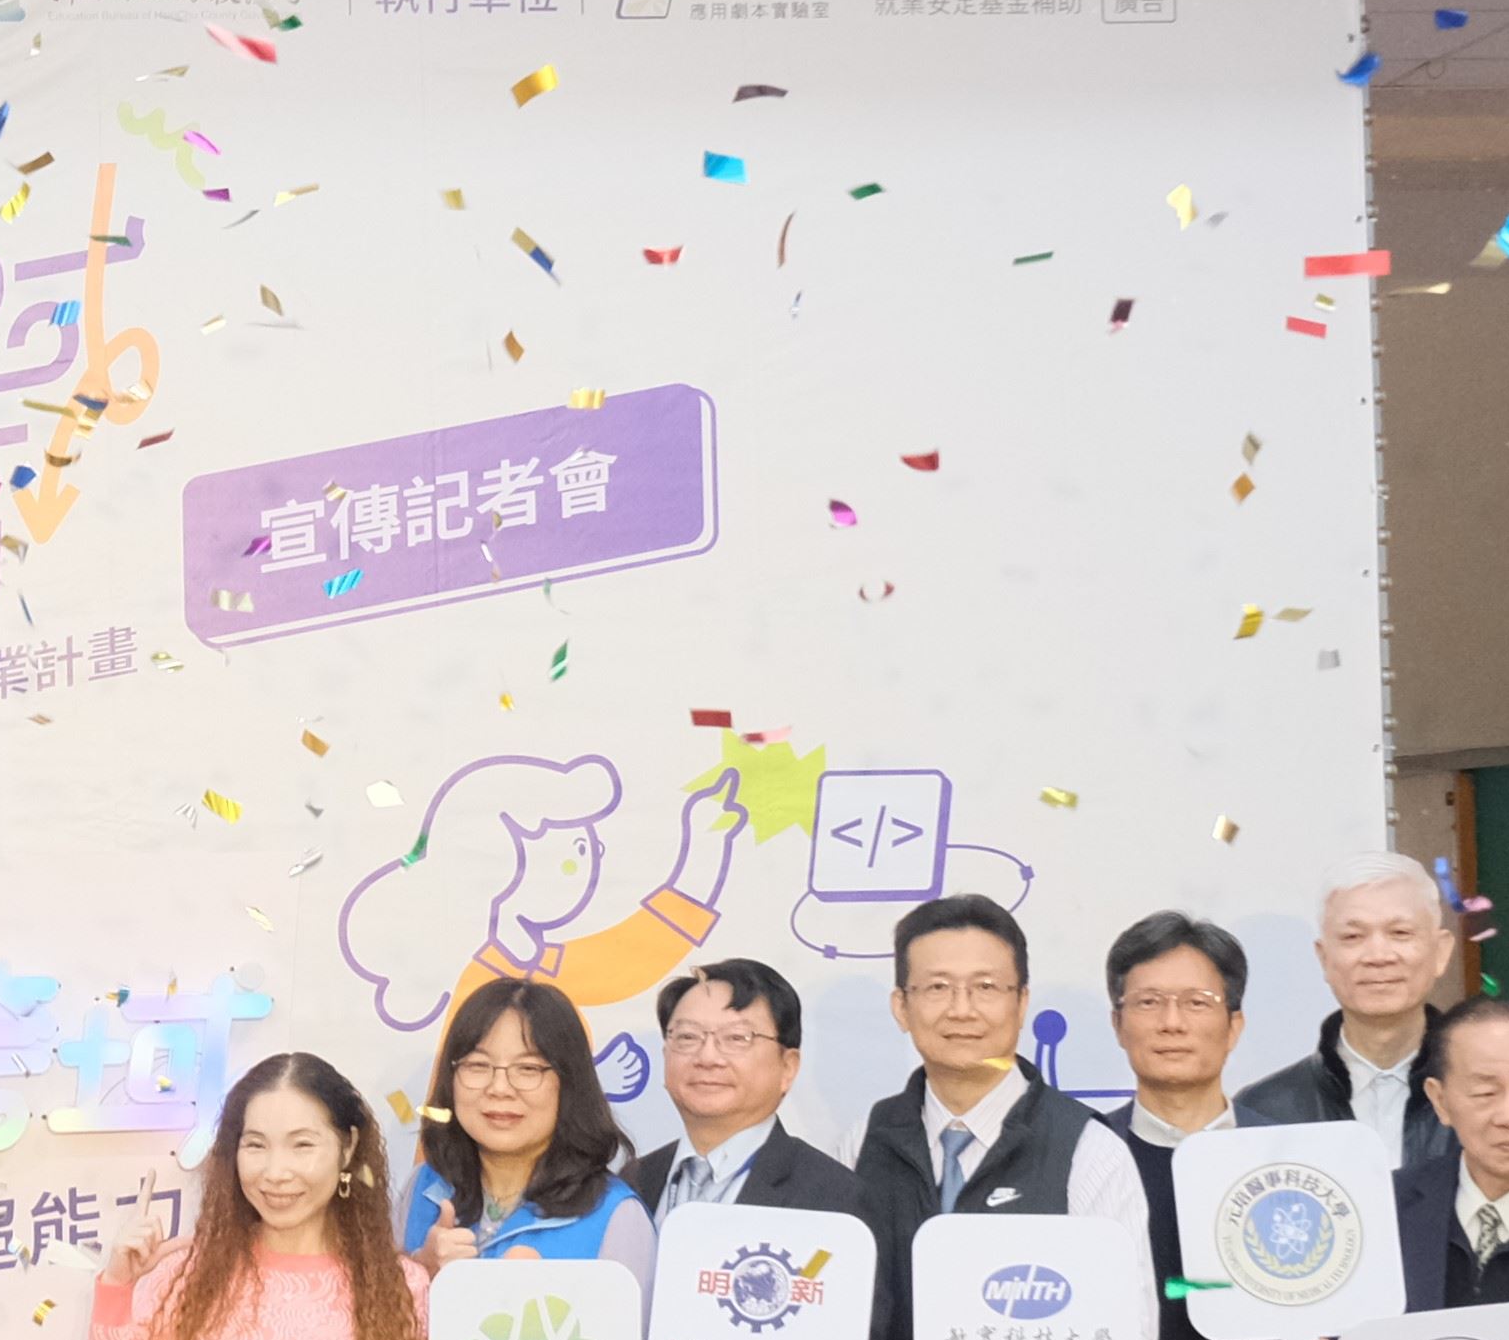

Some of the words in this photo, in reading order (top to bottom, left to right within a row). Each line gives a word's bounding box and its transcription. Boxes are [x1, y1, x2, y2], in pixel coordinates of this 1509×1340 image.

[689, 2, 831, 21] 應用劇本實驗室
[259, 451, 619, 576] 宣傳記者會
[697, 1270, 730, 1297] 明
[790, 1278, 824, 1305] 新
